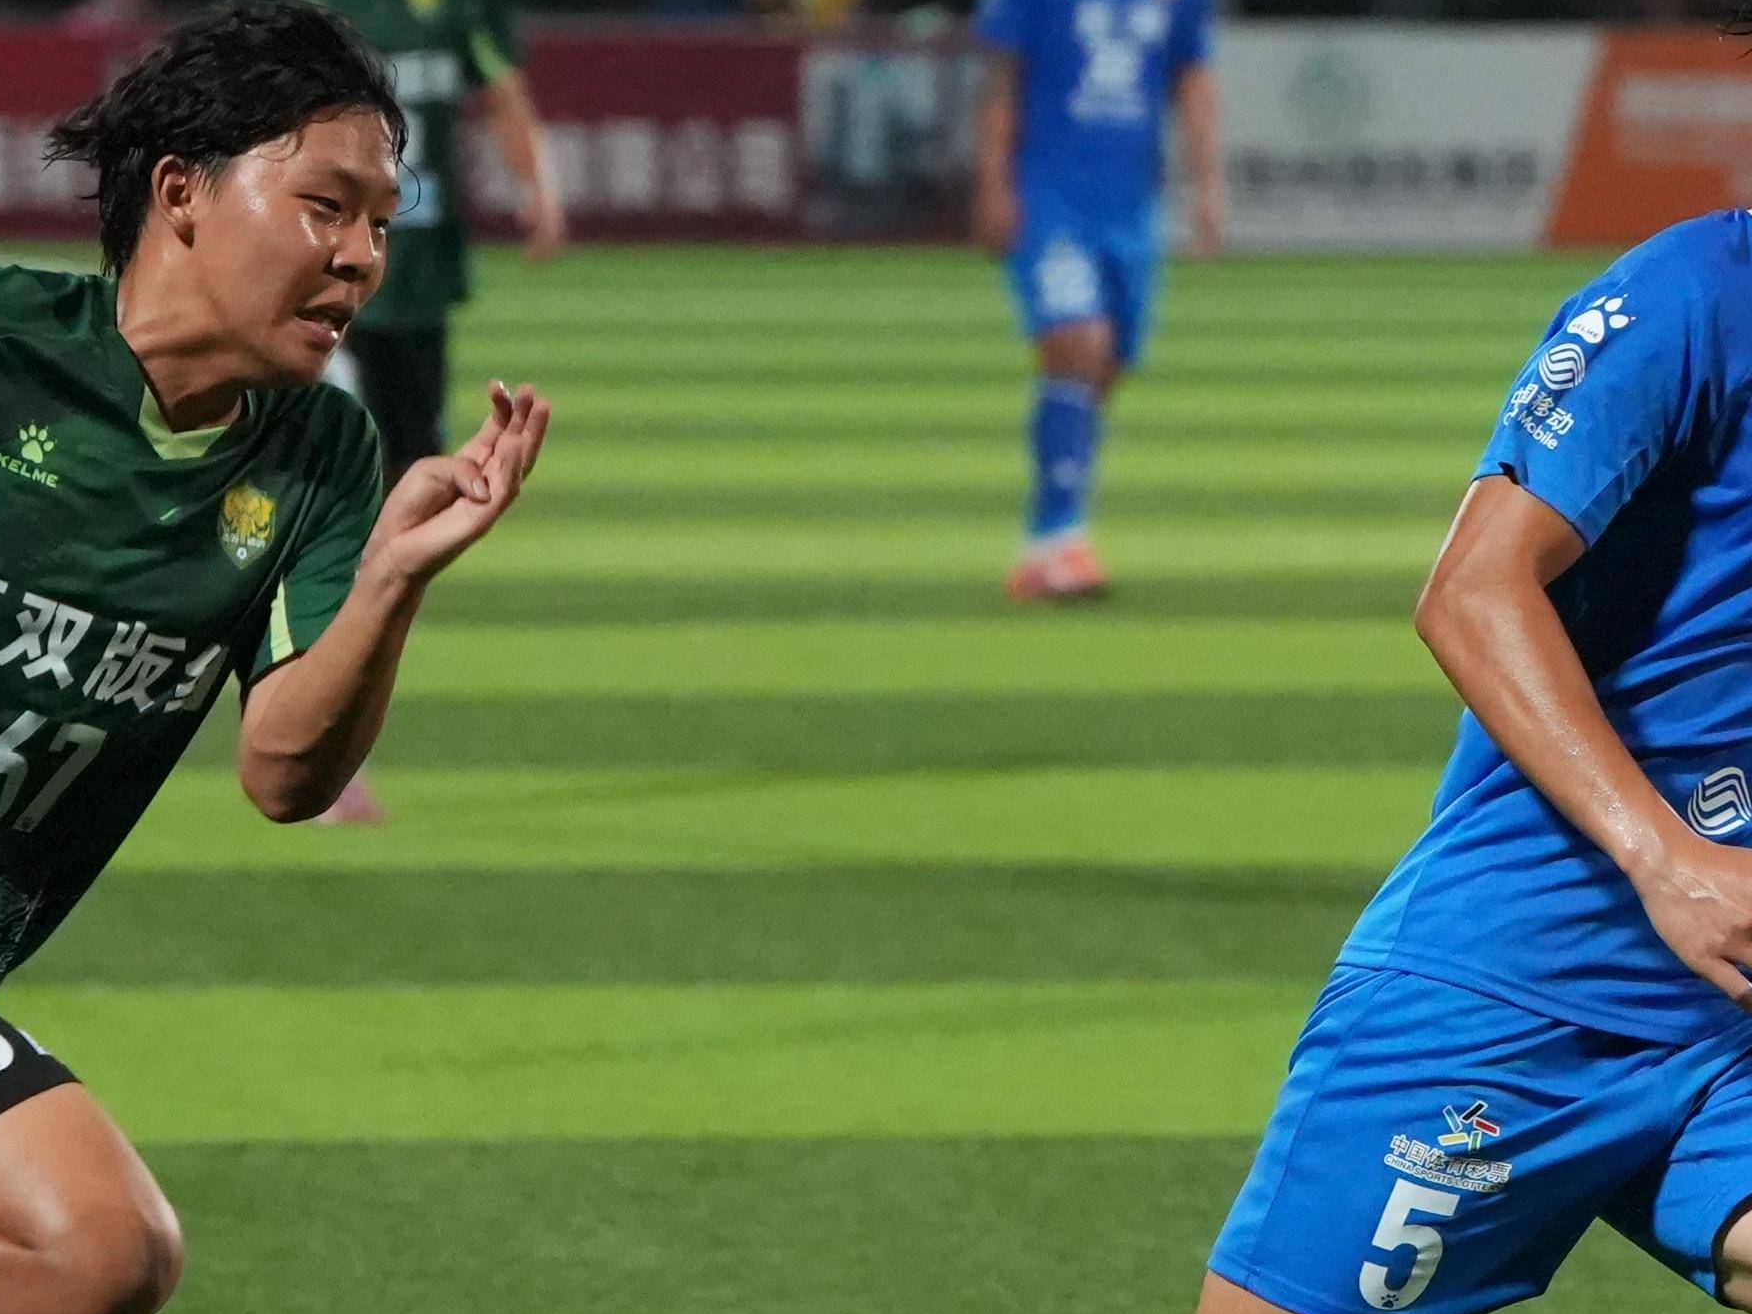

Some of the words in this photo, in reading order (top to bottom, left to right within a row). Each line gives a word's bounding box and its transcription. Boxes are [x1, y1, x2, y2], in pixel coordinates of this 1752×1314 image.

[1516, 410, 1559, 451] Mobile
[1384, 1154, 1413, 1176] CHINA
[1412, 1164, 1453, 1187] SPORTS
[1359, 1177, 1461, 1311] 5
